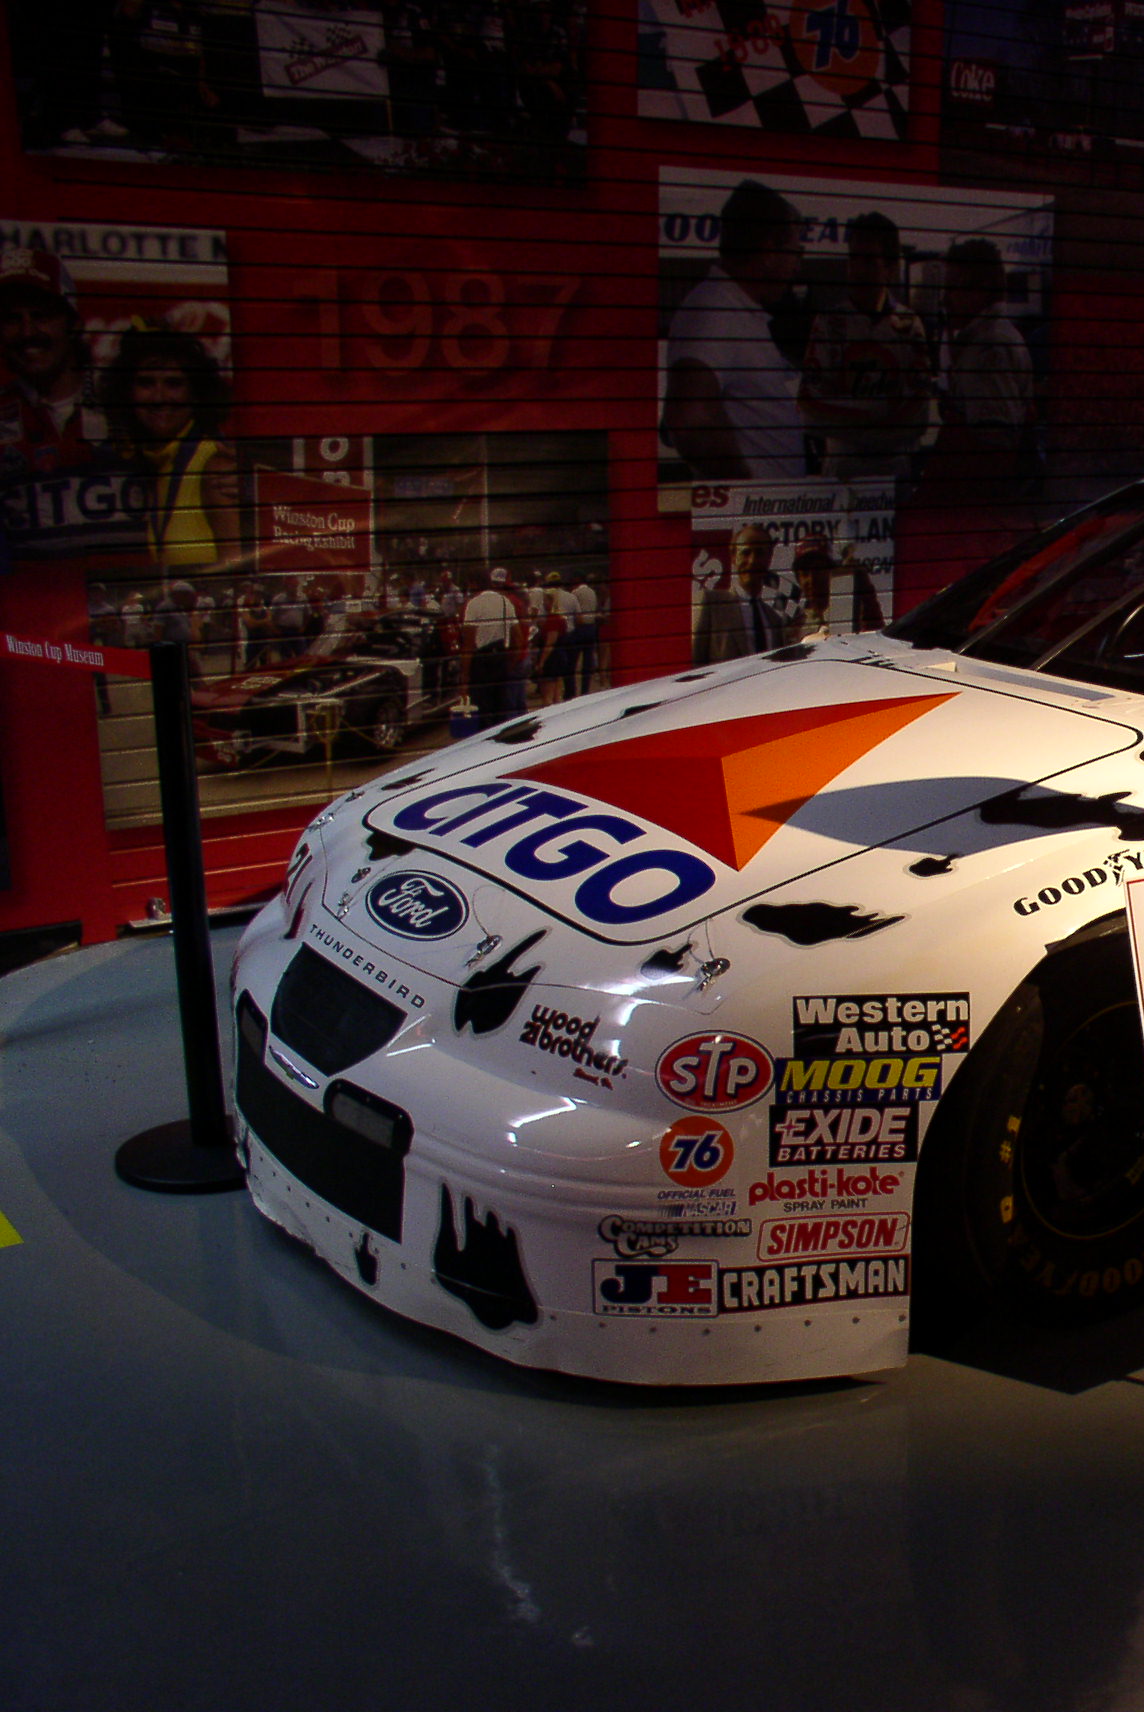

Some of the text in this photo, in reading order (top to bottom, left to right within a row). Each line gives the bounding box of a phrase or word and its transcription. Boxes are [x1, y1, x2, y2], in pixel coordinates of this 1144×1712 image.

[951, 61, 996, 92] Coke
[292, 262, 583, 377] 1987
[273, 505, 356, 532] Winston Cup
[743, 492, 836, 514] International
[6, 633, 105, 667] Winston Cup Museum
[393, 782, 717, 925] CITGO
[378, 877, 449, 928] Ford
[309, 923, 426, 1009] THUNDERBIRD
[531, 1004, 601, 1040] wood
[796, 996, 969, 1025] Western
[836, 1026, 930, 1053] Auto
[669, 1041, 758, 1097] STP
[780, 1056, 942, 1092] MOOG
[786, 1088, 933, 1103] CHASSIS PARTS
[774, 1107, 912, 1146] EXIDE
[668, 1129, 725, 1172] 76
[776, 1143, 906, 1163] BATTERIES
[657, 1188, 736, 1200] OFFICIAL FUEL
[749, 1166, 901, 1206] plasti-kote
[783, 1198, 868, 1213] SPRAY PAINT
[766, 1217, 900, 1256] SIMPSON
[600, 1263, 713, 1305] JE
[722, 1258, 906, 1309] CRAFTSMAN
[601, 1304, 712, 1315] PISTONS
